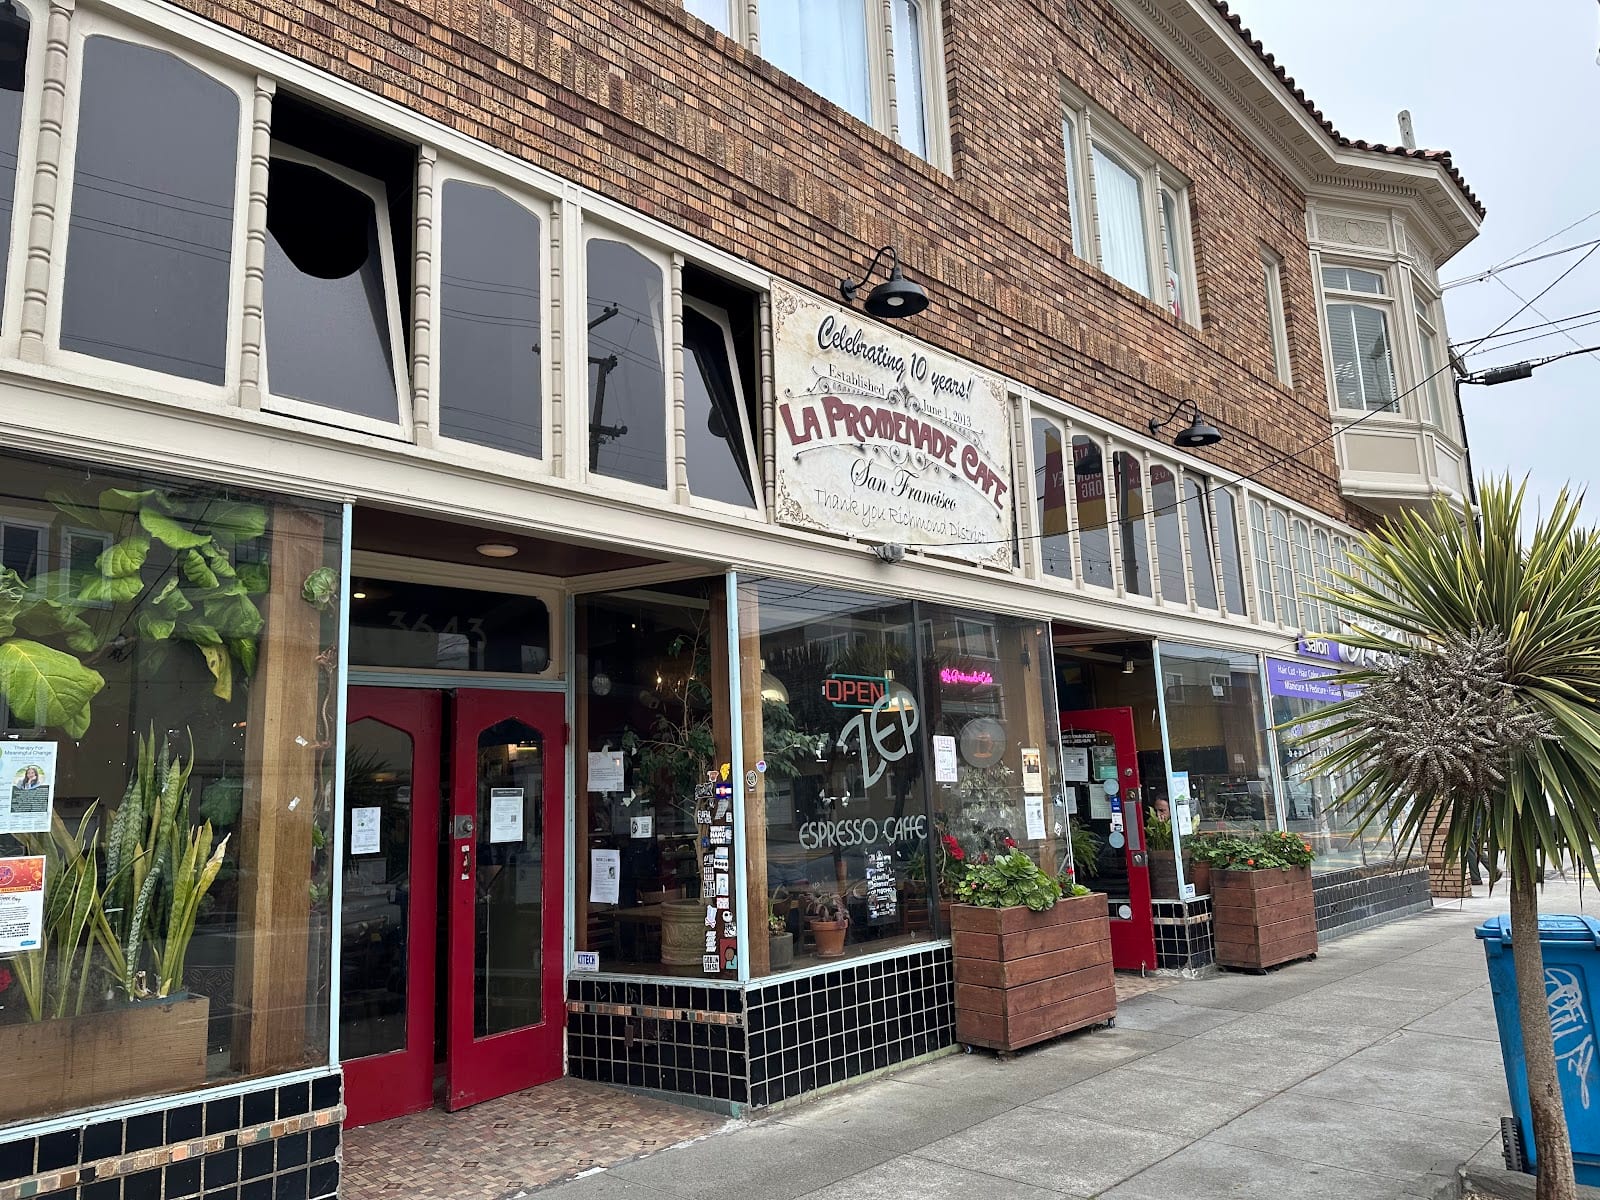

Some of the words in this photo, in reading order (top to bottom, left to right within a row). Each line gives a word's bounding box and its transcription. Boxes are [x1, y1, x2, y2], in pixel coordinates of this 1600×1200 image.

[818, 315, 906, 383] Celebrating
[910, 352, 927, 381] 10
[931, 371, 972, 399] years!
[829, 364, 885, 396] Established
[921, 399, 942, 416] June
[953, 411, 972, 427] 2013
[779, 403, 822, 445] LA
[820, 396, 958, 469] PROMENADE
[961, 444, 1008, 510] CAFE
[851, 458, 888, 492] San
[891, 466, 957, 511] Francisco
[814, 488, 859, 516] Thank
[862, 501, 886, 527] you
[889, 507, 947, 536] Richmond
[1277, 665, 1287, 674] Hair
[1287, 666, 1296, 676] Cut
[825, 680, 884, 704] OPEN
[836, 690, 921, 790] ZEP
[799, 817, 878, 850] ESPRESSO
[883, 814, 928, 842] CAFFE
